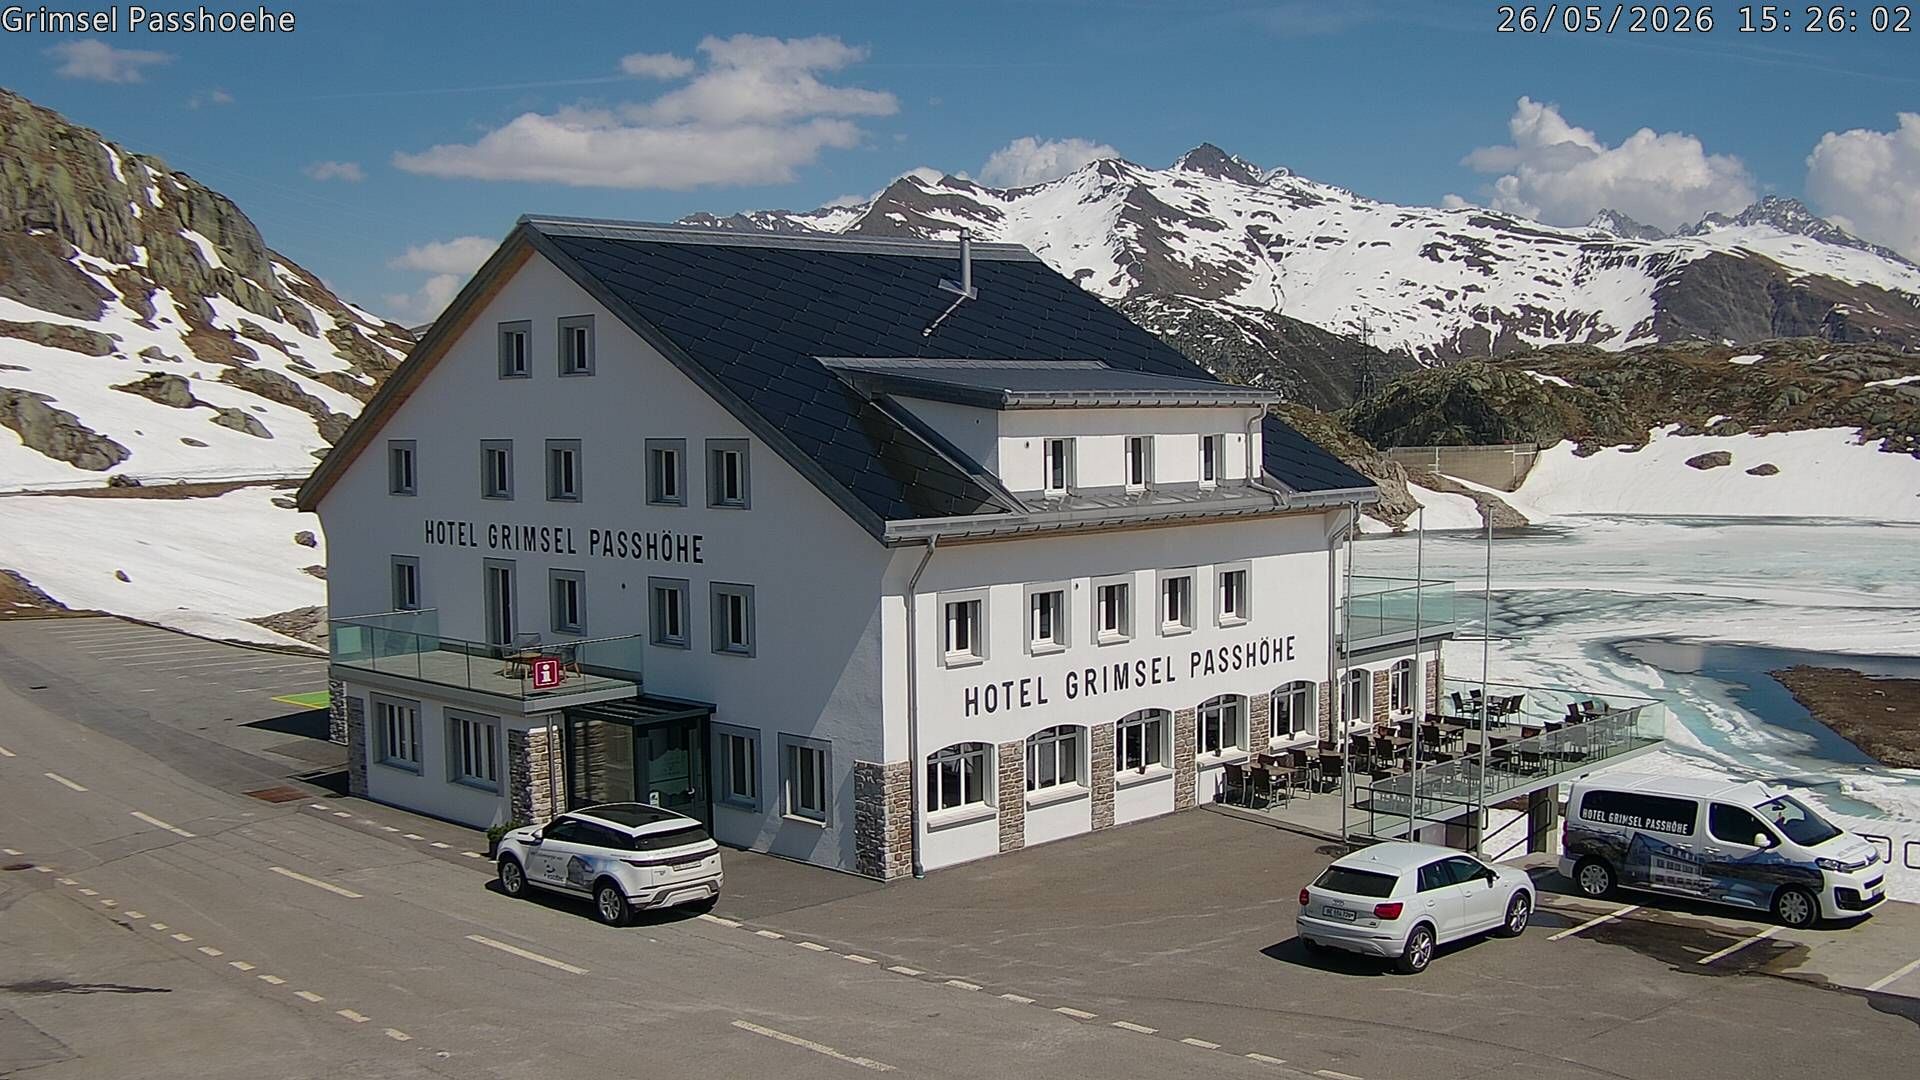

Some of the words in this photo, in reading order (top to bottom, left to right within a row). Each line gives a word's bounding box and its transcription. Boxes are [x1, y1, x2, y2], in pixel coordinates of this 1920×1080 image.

[424, 519, 478, 547] HOTEL
[488, 523, 577, 555] GRIMSEL
[589, 528, 704, 564] PASSHÖHE
[964, 675, 1048, 717] HOTEL
[1065, 655, 1176, 699] GRIMSEL
[1190, 635, 1296, 678] PASSHÖHE
[1582, 808, 1606, 822] HOTEL
[1608, 812, 1643, 828] GRIMSEL
[1645, 817, 1689, 834] PASSHÖHE
